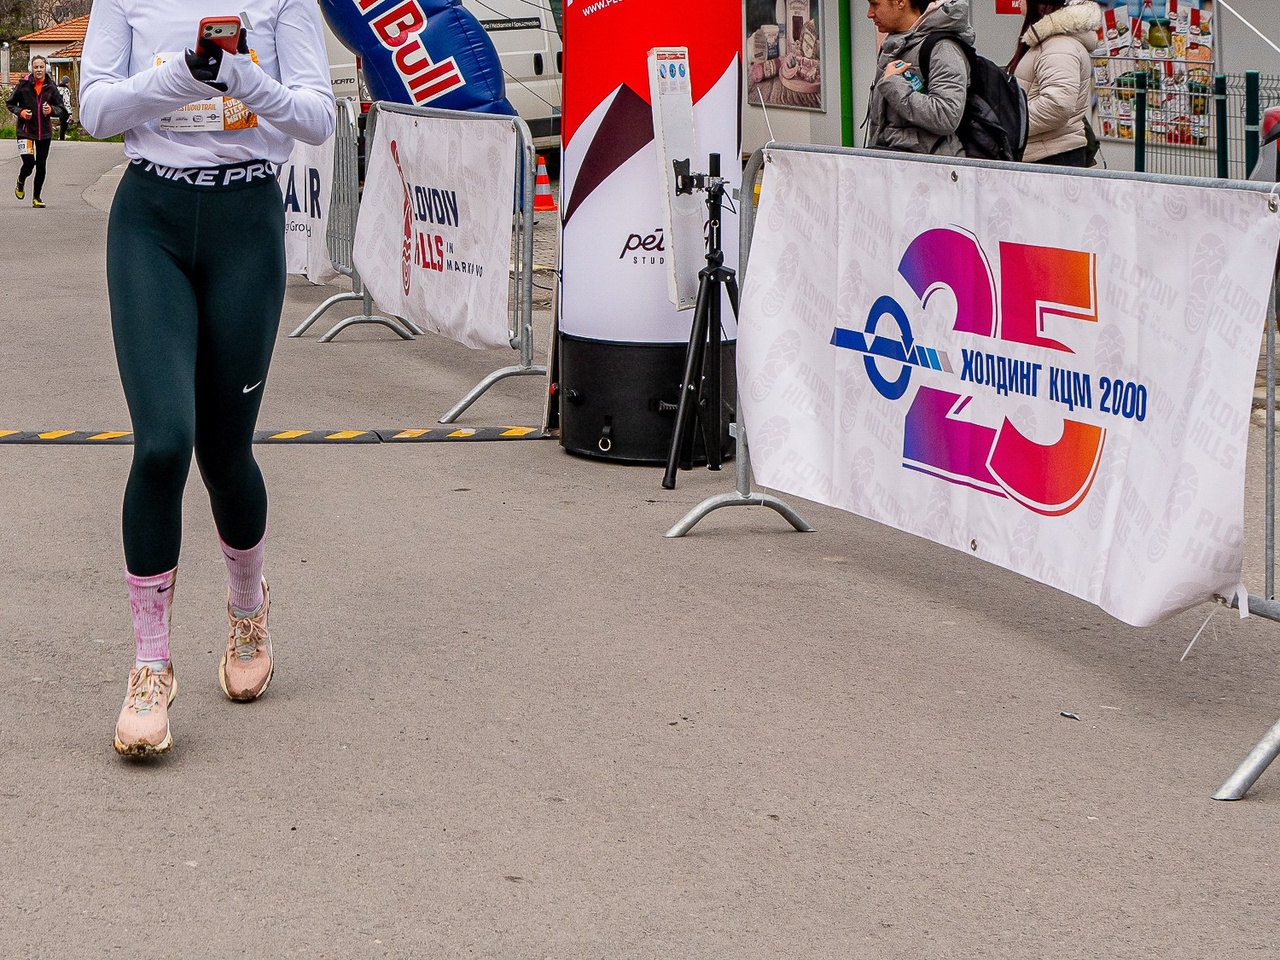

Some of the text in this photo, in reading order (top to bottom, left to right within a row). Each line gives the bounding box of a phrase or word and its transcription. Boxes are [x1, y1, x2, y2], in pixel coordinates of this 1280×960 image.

[201, 103, 217, 111] TRAIL
[144, 160, 220, 186] NIKE
[446, 242, 454, 254] IN
[960, 348, 1148, 423] ХОЛДИНГ КЦМ 2000
